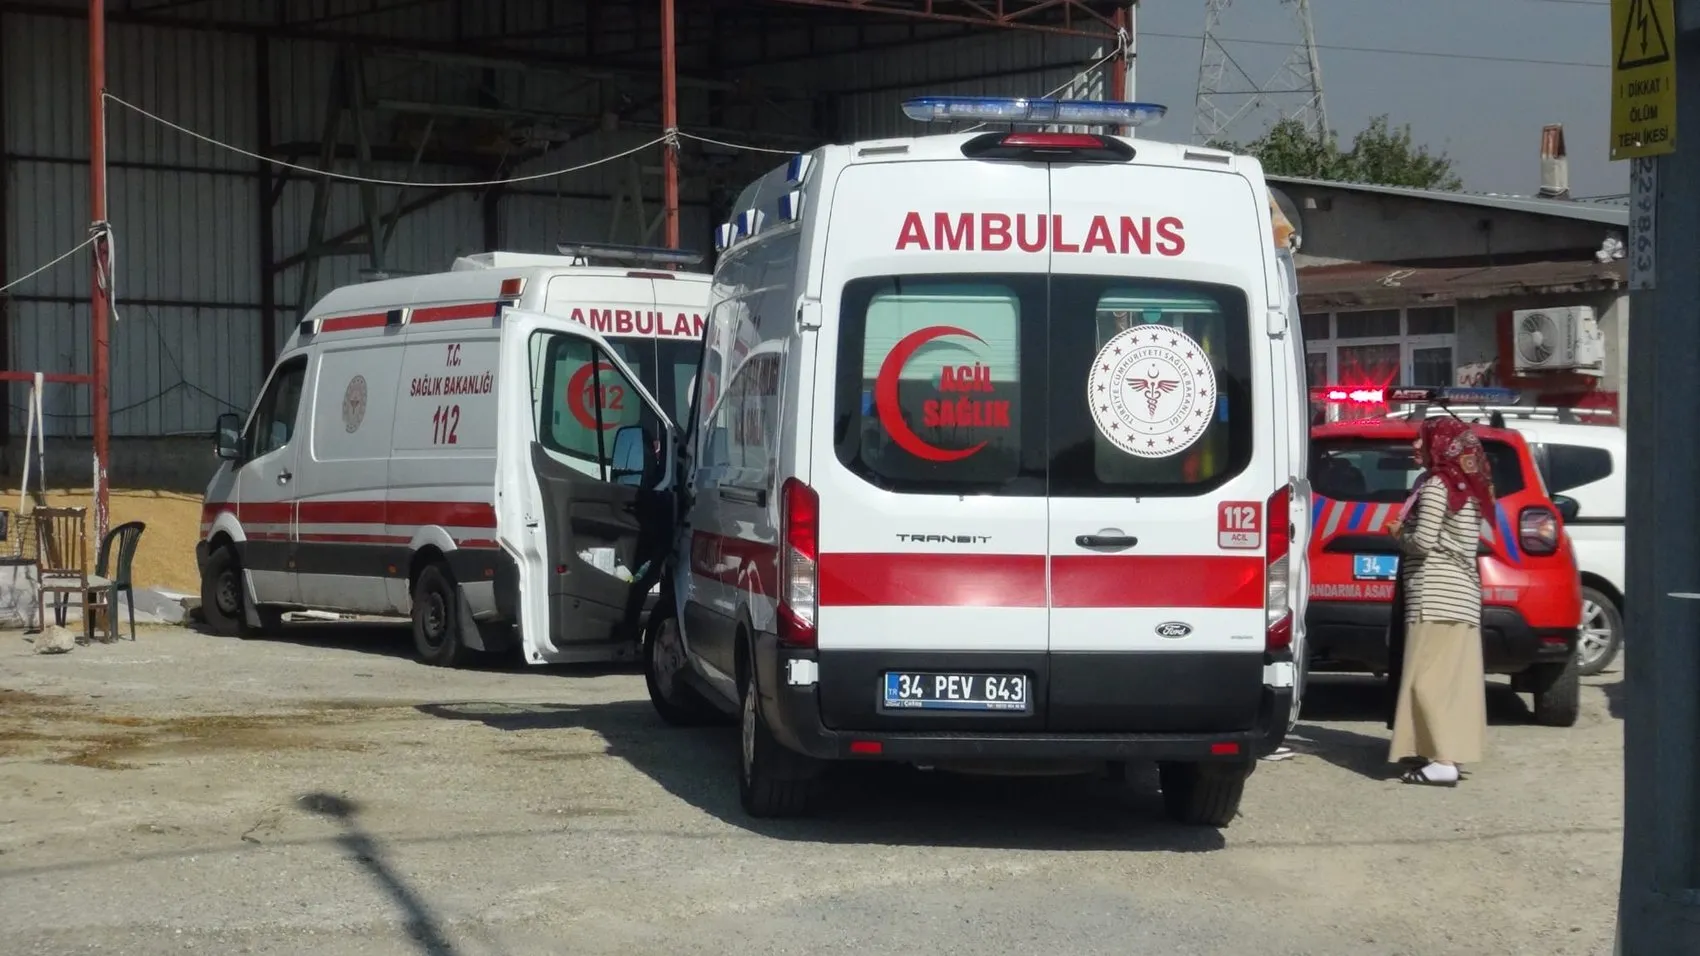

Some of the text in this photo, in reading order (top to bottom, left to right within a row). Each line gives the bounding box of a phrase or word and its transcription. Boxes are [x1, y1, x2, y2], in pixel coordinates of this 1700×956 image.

[1628, 77, 1661, 98] DİKKAT
[1629, 104, 1658, 123] ÖLÜM
[1618, 125, 1669, 148] TEHLİKESİ
[895, 211, 1185, 256] AMBULANS
[570, 307, 708, 337] AMBULAN
[446, 343, 462, 367] T.C.
[410, 369, 494, 397] SAĞLIK BAKANLIĞI
[583, 383, 624, 411] 112
[922, 394, 1011, 428] SAĞLIK
[432, 404, 461, 445] 112
[1224, 506, 1256, 529] 112
[896, 533, 992, 544] TRANSIT
[1362, 557, 1380, 573] 34
[1309, 583, 1395, 598] ANDARMA ASAY
[1159, 623, 1188, 637] Ford
[899, 674, 923, 699] 34
[935, 675, 974, 700] PEV
[985, 676, 1022, 701] 643
